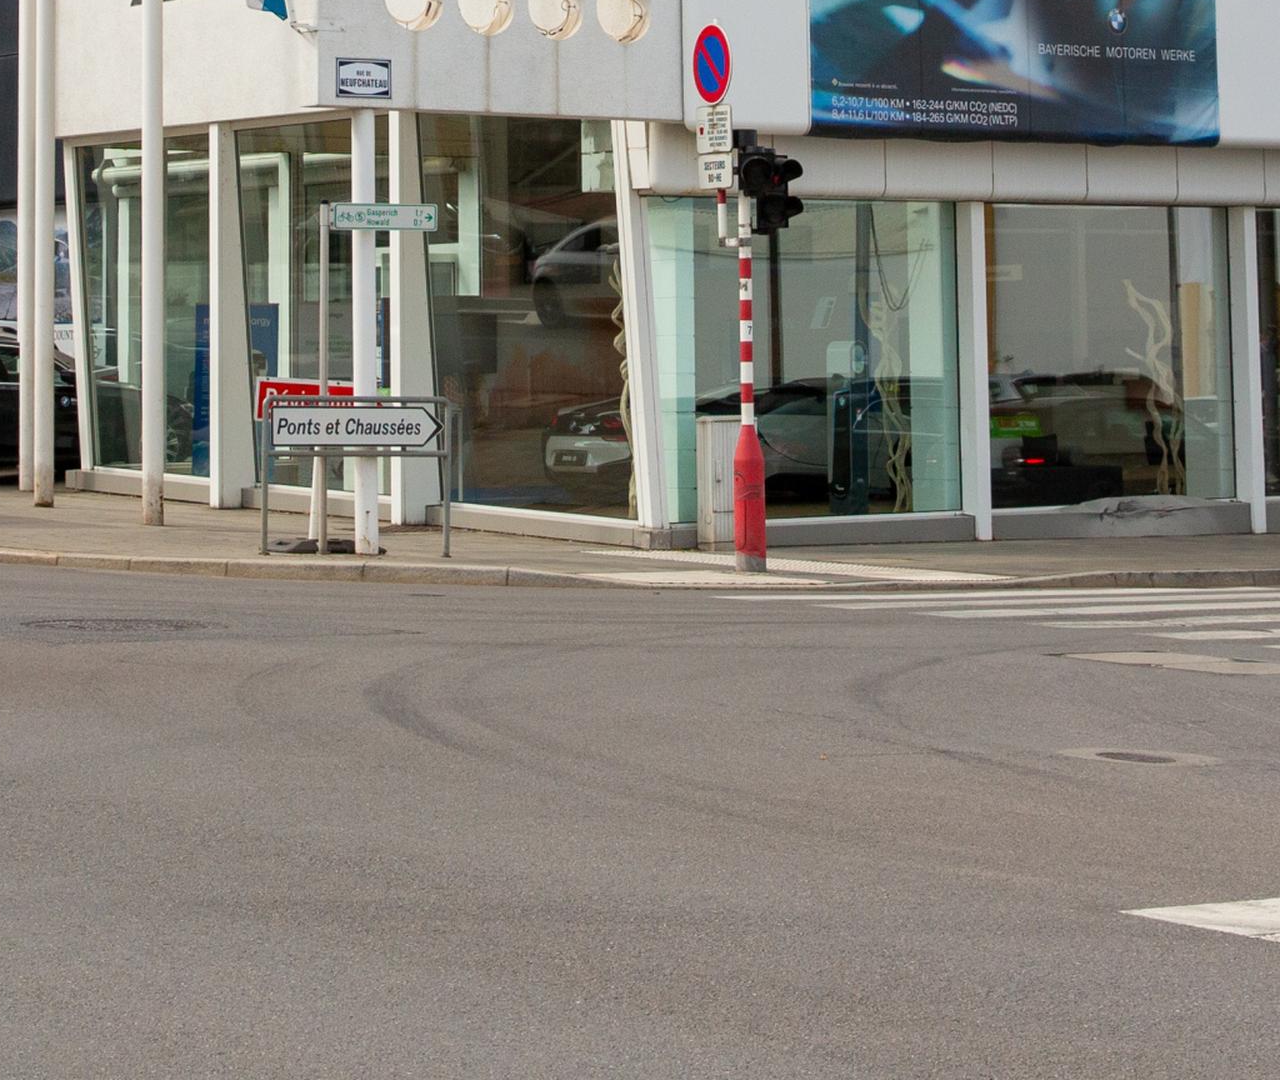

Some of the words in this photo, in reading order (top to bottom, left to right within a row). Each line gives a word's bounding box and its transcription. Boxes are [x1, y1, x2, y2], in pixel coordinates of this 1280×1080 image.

[1038, 43, 1101, 58] BAYERISCHE
[1106, 46, 1156, 60] MOTOREN
[1160, 49, 1196, 62] WERKE
[340, 78, 389, 88] NEUFCHATEAU
[865, 96, 888, 108] L/100
[890, 98, 905, 108] KM
[912, 99, 945, 110] 162-244
[946, 100, 968, 111] G/KM
[989, 102, 1018, 114] (NEDC)
[865, 109, 888, 121] L/100
[890, 110, 905, 121] KM
[912, 112, 945, 123] 184-265
[946, 113, 969, 124] G/KM
[989, 114, 1018, 127] (WLTP)
[704, 160, 726, 171] SECTEURS
[367, 208, 399, 217] Gasperich
[276, 418, 321, 436] Ponts
[325, 419, 341, 436] et
[345, 417, 421, 436] Chaussées
